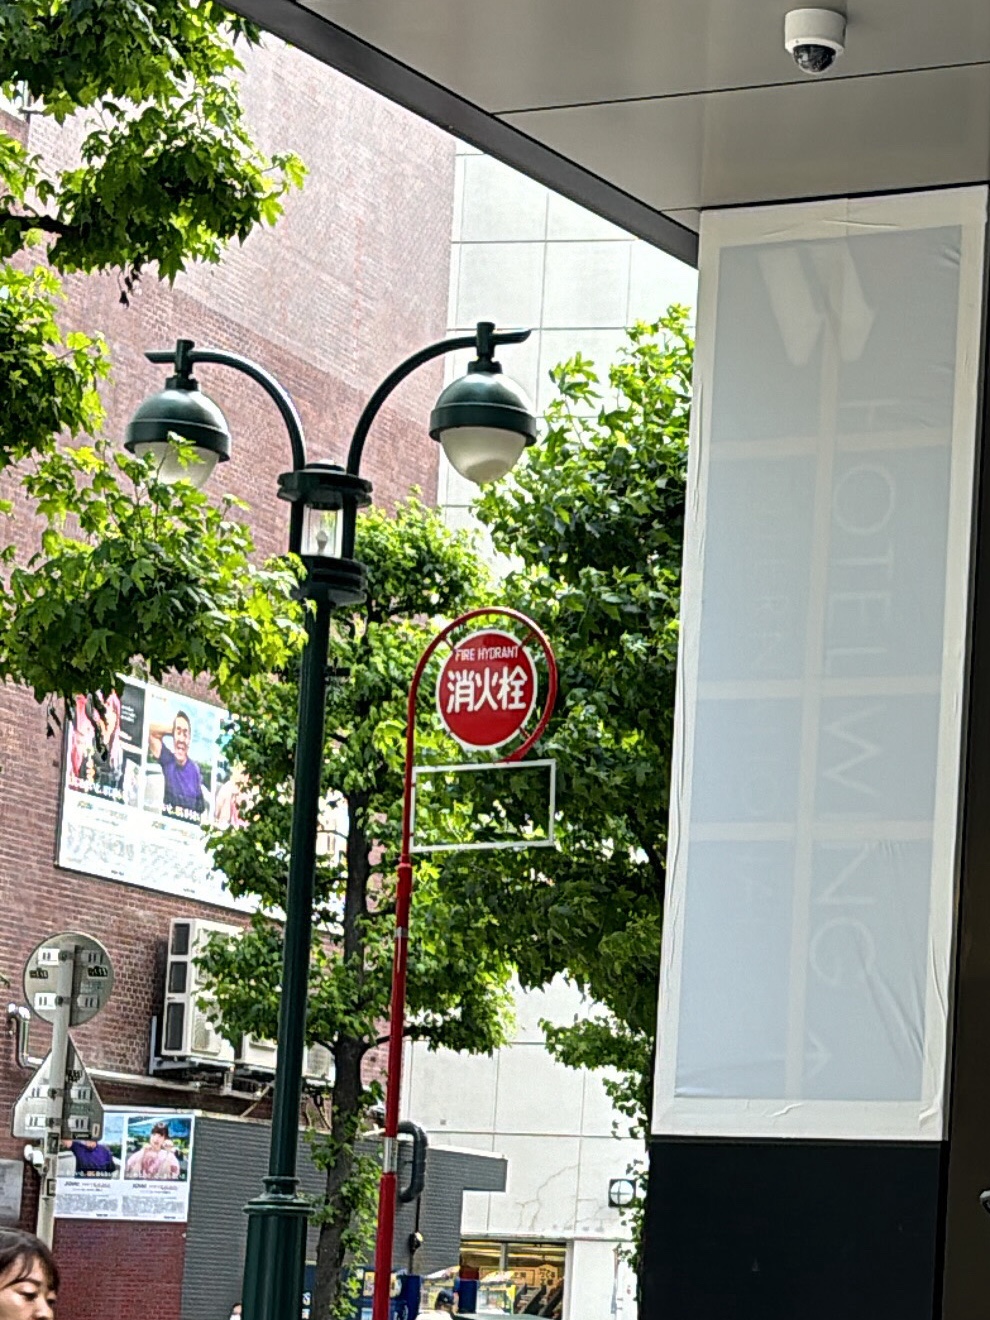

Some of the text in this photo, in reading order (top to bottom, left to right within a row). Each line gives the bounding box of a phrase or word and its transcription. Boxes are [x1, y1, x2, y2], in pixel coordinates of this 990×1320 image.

[454, 646, 519, 661] FIRE HYDRANT
[446, 665, 528, 714] 消火栓
